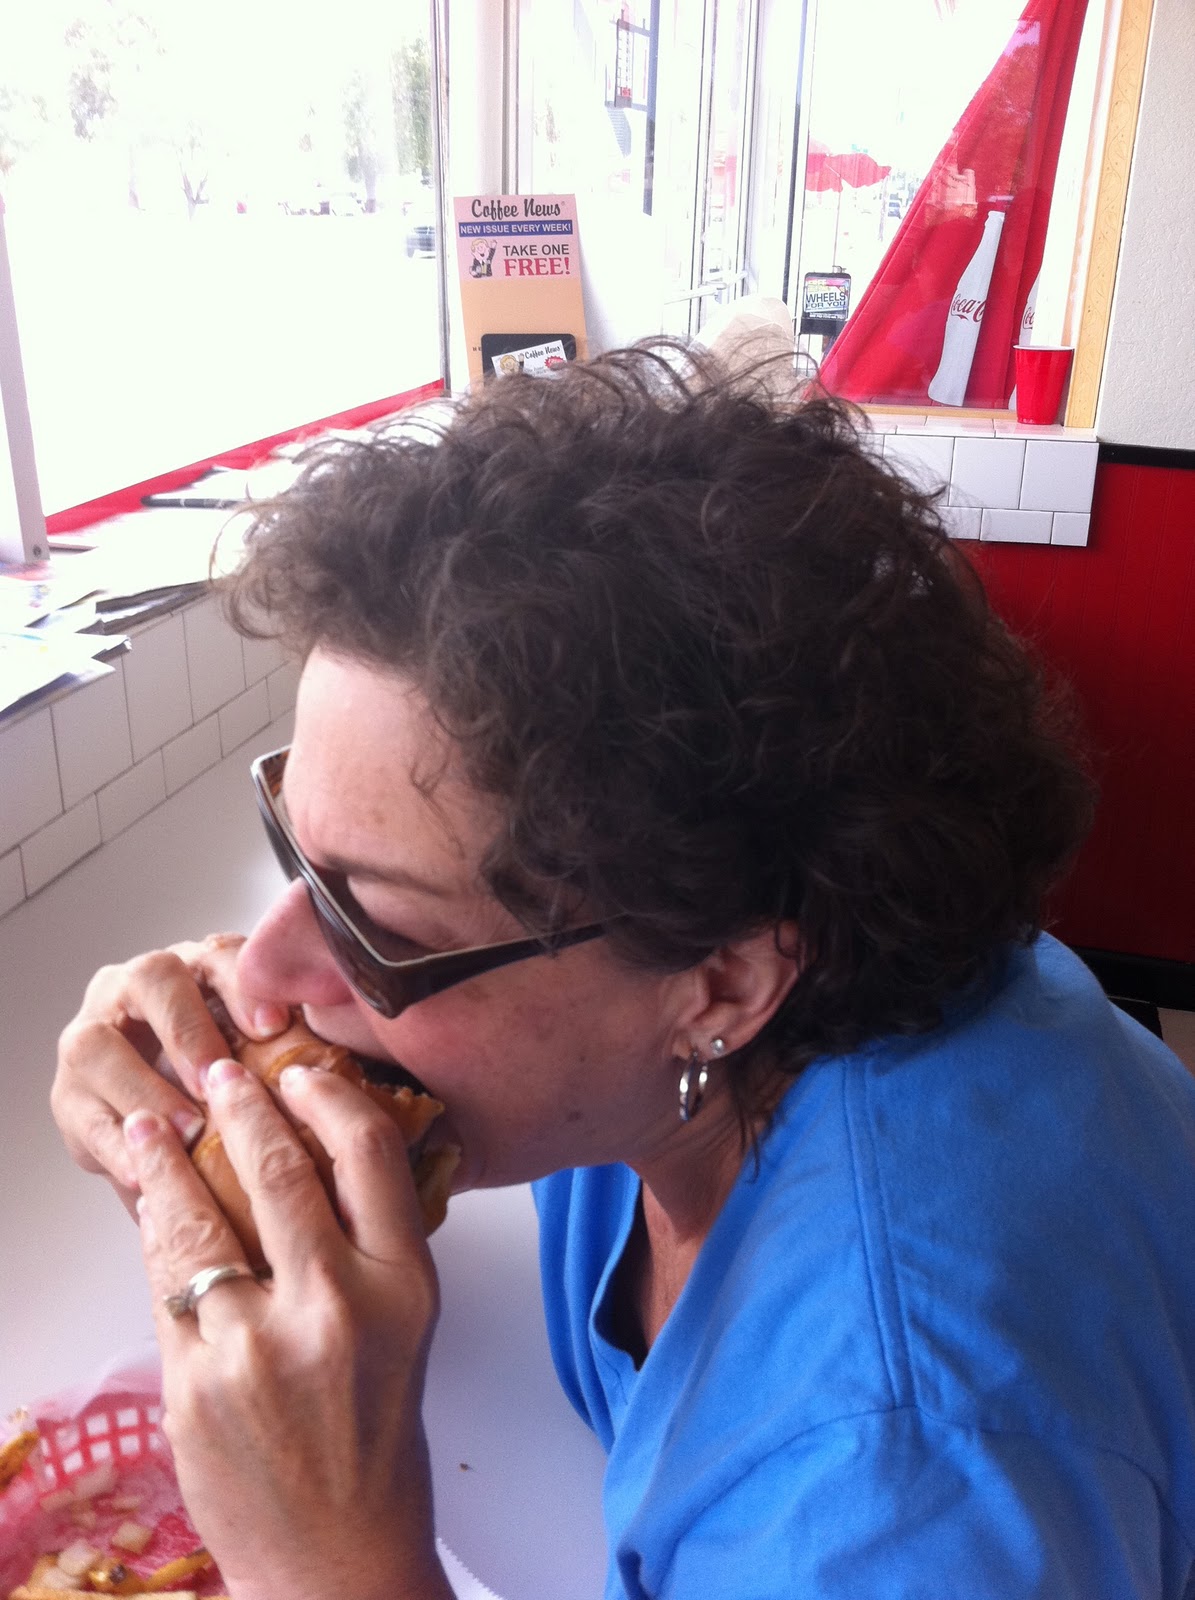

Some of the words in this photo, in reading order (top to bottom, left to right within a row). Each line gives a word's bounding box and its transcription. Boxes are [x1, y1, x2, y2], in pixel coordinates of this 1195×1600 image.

[472, 199, 518, 220] Coffee
[524, 198, 560, 217] News
[460, 225, 481, 234] NEW
[483, 225, 509, 233] ISSUE
[512, 224, 540, 233] EVERY
[542, 223, 571, 232] WEEK!
[503, 245, 538, 256] TAKE
[542, 244, 569, 255] ONE
[504, 257, 570, 276] FREE!
[806, 292, 846, 303] WHEELS
[525, 351, 544, 360] Coffee
